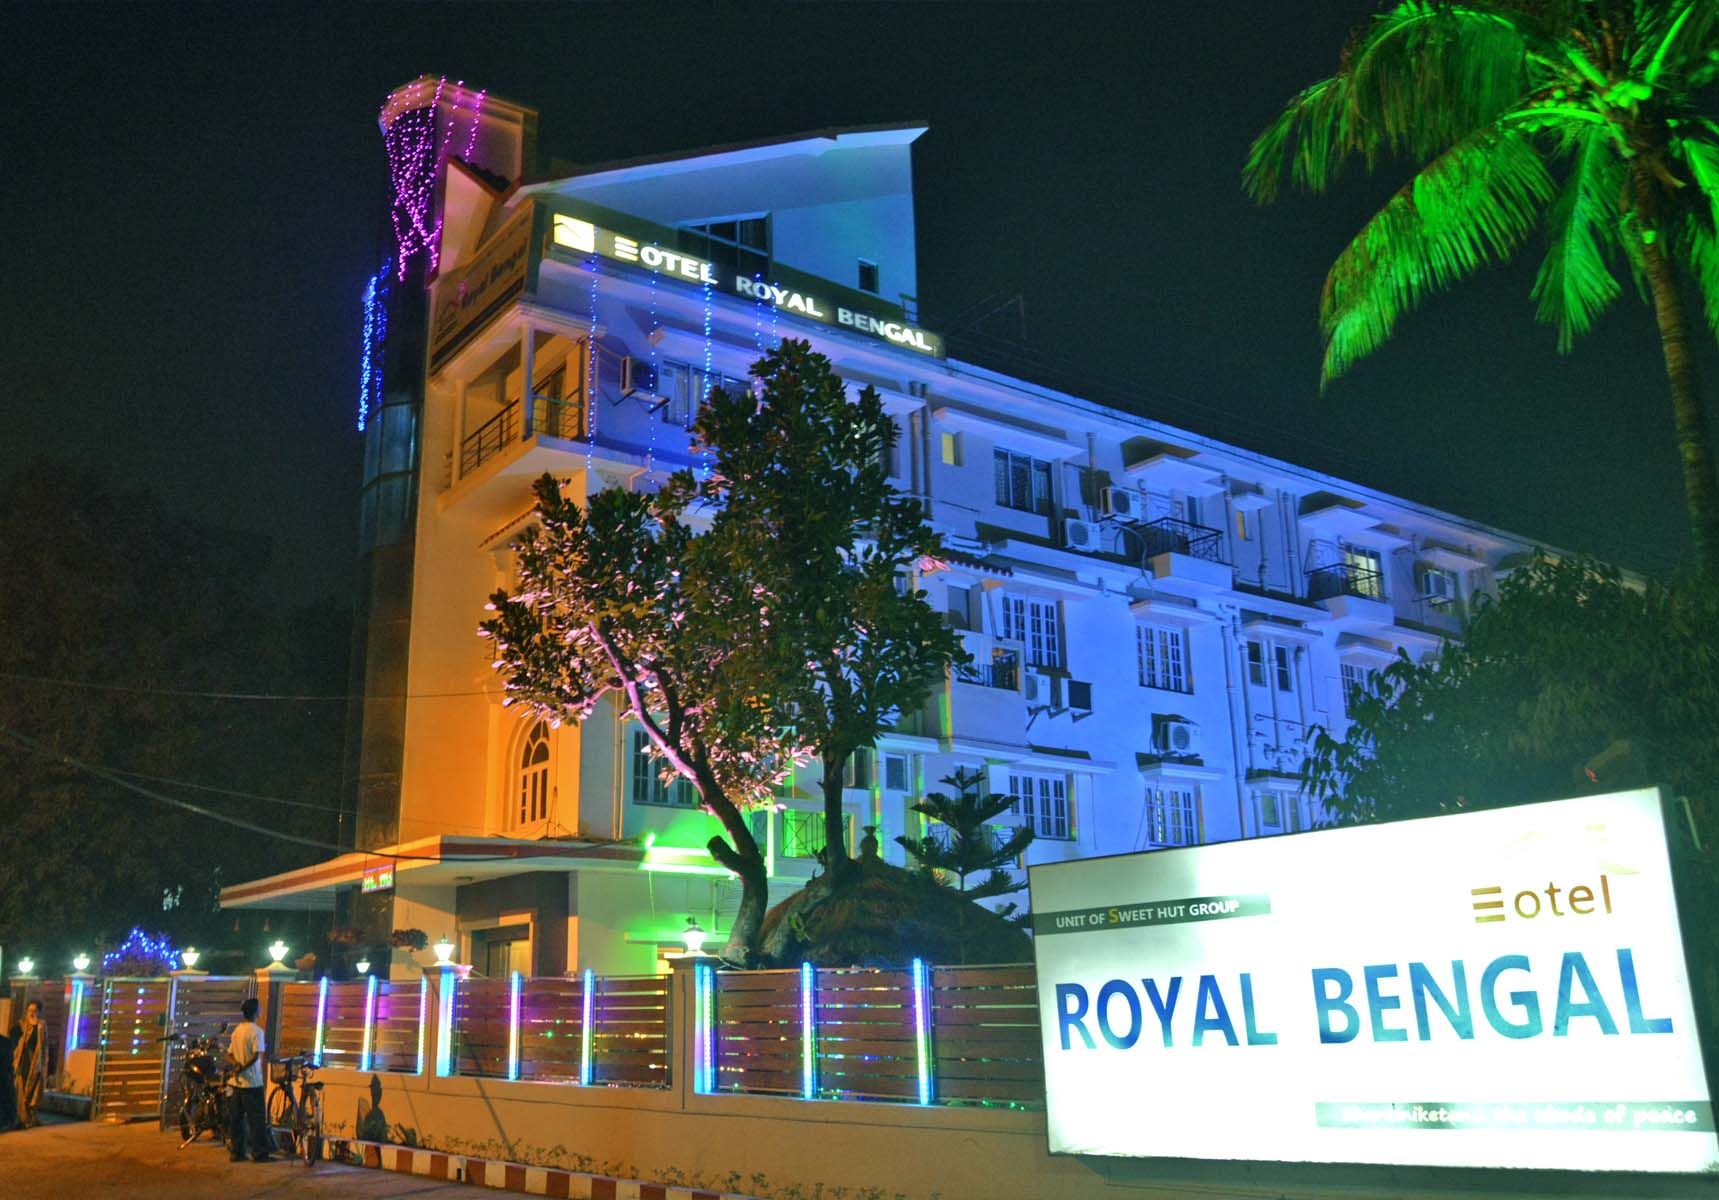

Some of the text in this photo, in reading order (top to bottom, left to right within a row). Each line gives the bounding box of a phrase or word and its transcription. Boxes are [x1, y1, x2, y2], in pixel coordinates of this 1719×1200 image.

[735, 274, 824, 318] ROYAL
[837, 306, 933, 352] BENGAL
[1056, 900, 1240, 929] UNIT OF SWEET HUT GROUP
[1054, 947, 1674, 1051] ROYAL BENGAL
